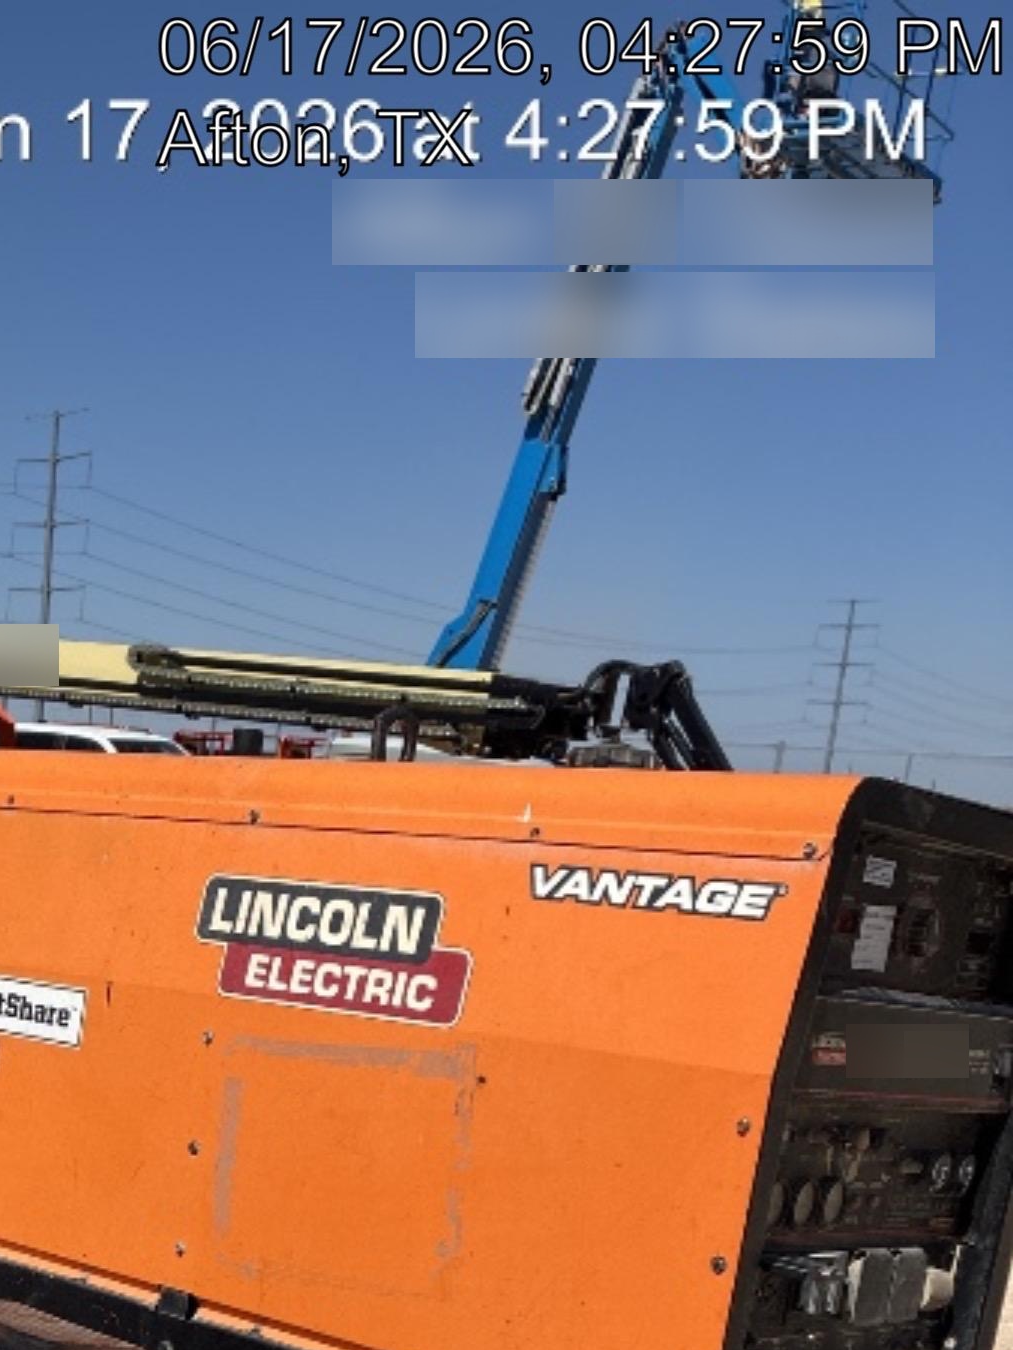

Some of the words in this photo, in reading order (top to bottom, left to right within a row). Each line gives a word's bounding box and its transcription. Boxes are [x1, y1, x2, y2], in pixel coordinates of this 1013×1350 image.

[208, 886, 428, 955] LINCOLN
[530, 864, 780, 922] VANTAGE
[243, 952, 438, 1013] ELECTRIC
